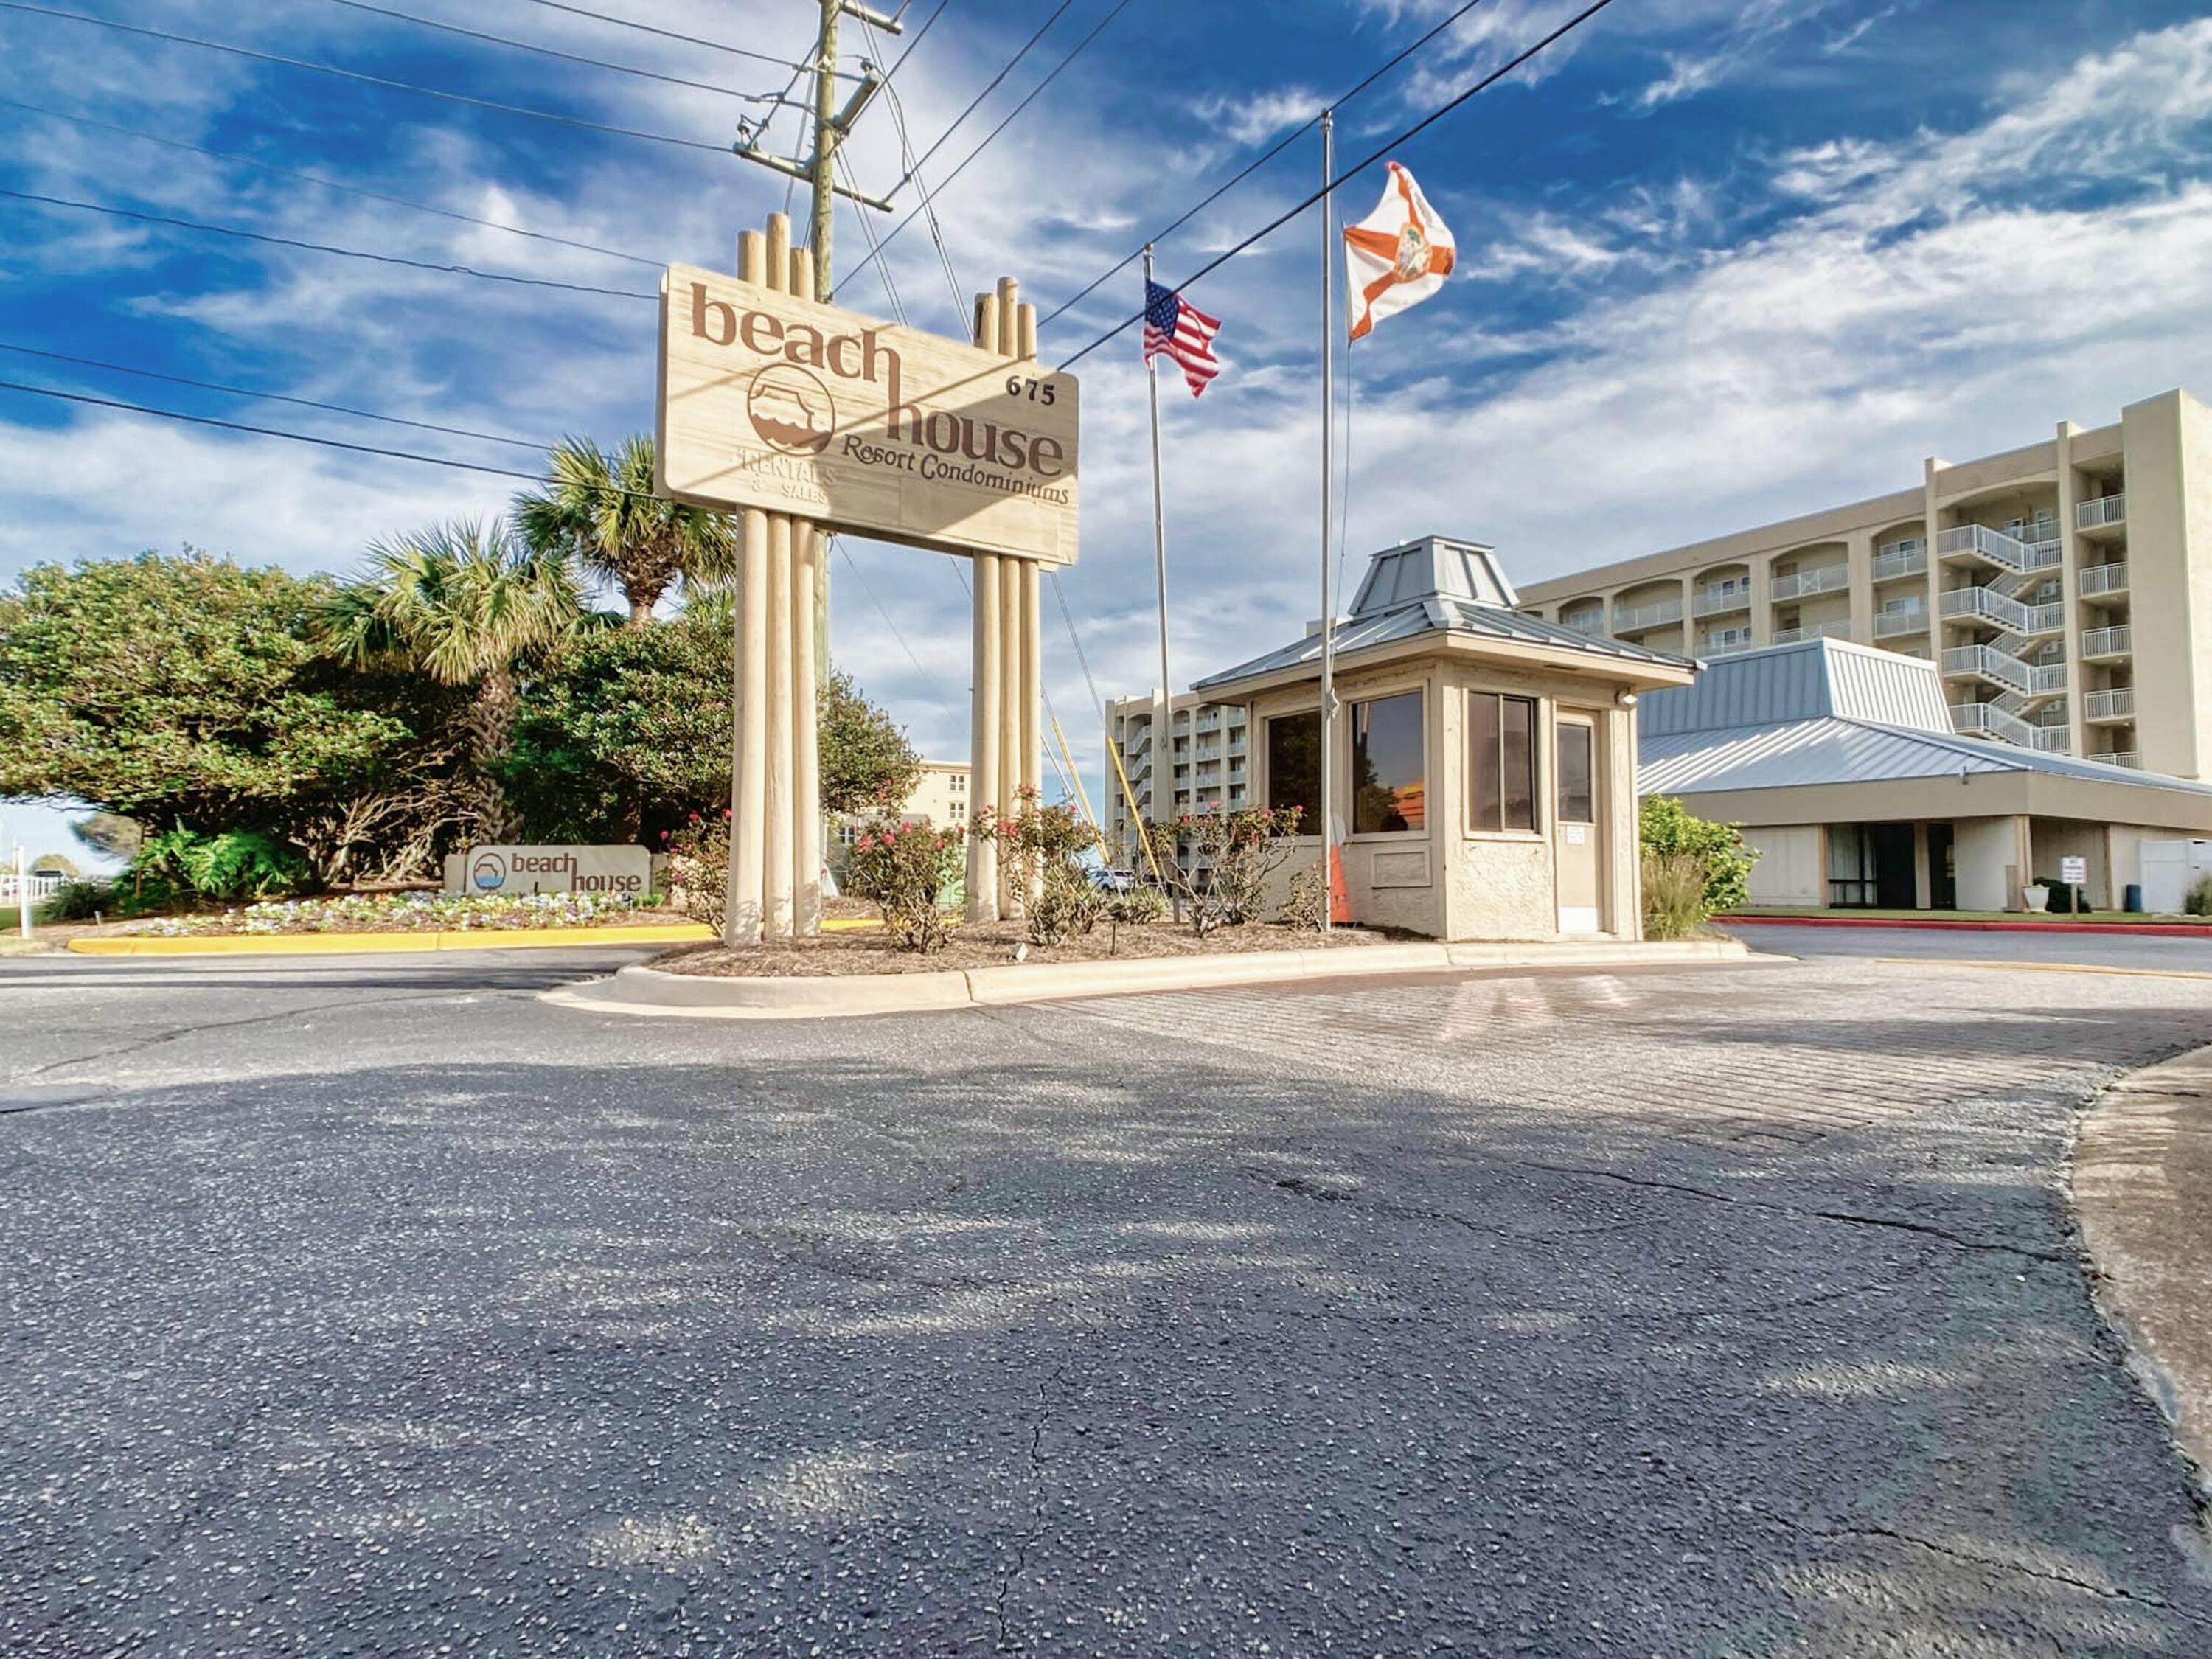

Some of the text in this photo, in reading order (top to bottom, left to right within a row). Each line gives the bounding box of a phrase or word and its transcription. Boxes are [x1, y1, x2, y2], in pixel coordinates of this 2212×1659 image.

[690, 282, 901, 385] beach
[1006, 375, 1055, 406] 675
[887, 378, 1063, 476] house
[842, 434, 1069, 504] Resort Condominiums
[512, 852, 578, 872] beach
[571, 869, 641, 892] house
